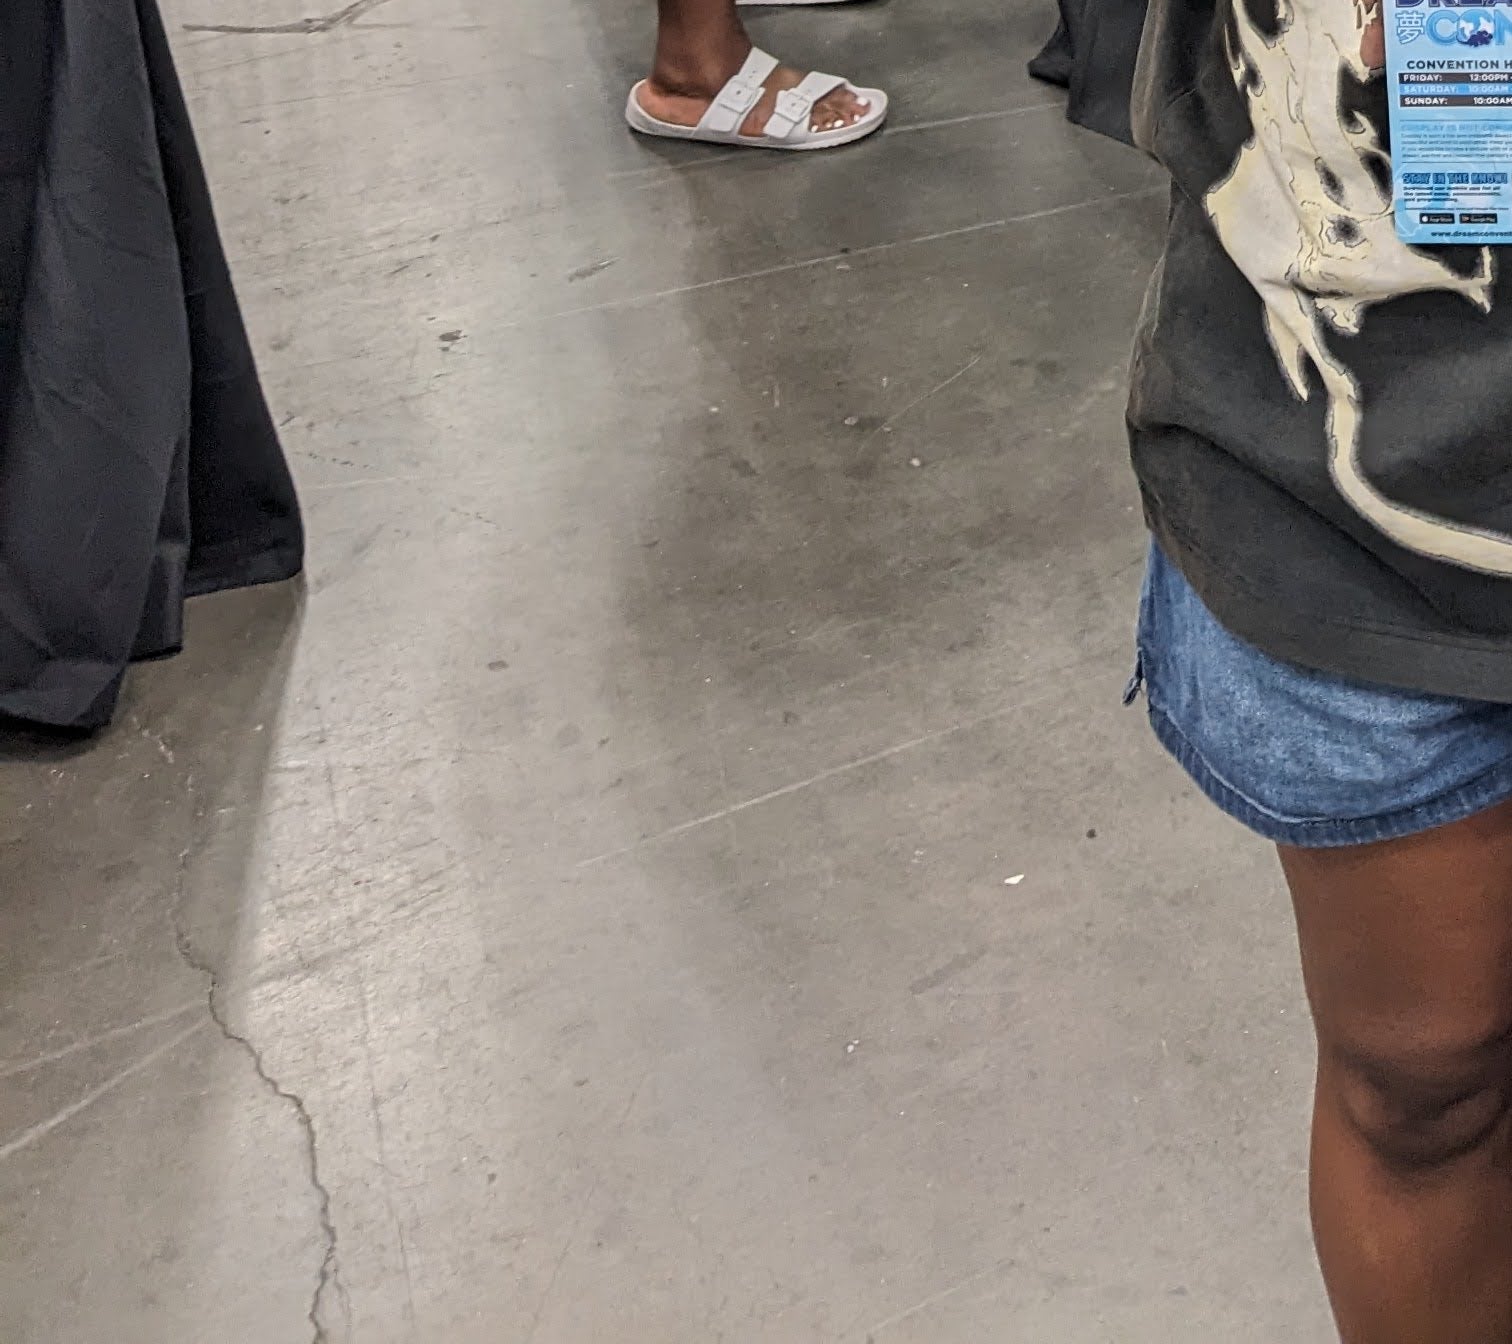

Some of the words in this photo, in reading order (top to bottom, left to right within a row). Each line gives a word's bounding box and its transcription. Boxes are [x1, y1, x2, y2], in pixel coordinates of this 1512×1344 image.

[1395, 10, 1425, 45] 夢
[1407, 60, 1500, 70] CONVENTION
[1403, 74, 1443, 82] FRIDAY:
[1470, 73, 1508, 81] 12:00PM
[1404, 97, 1448, 105] SUNDAY:
